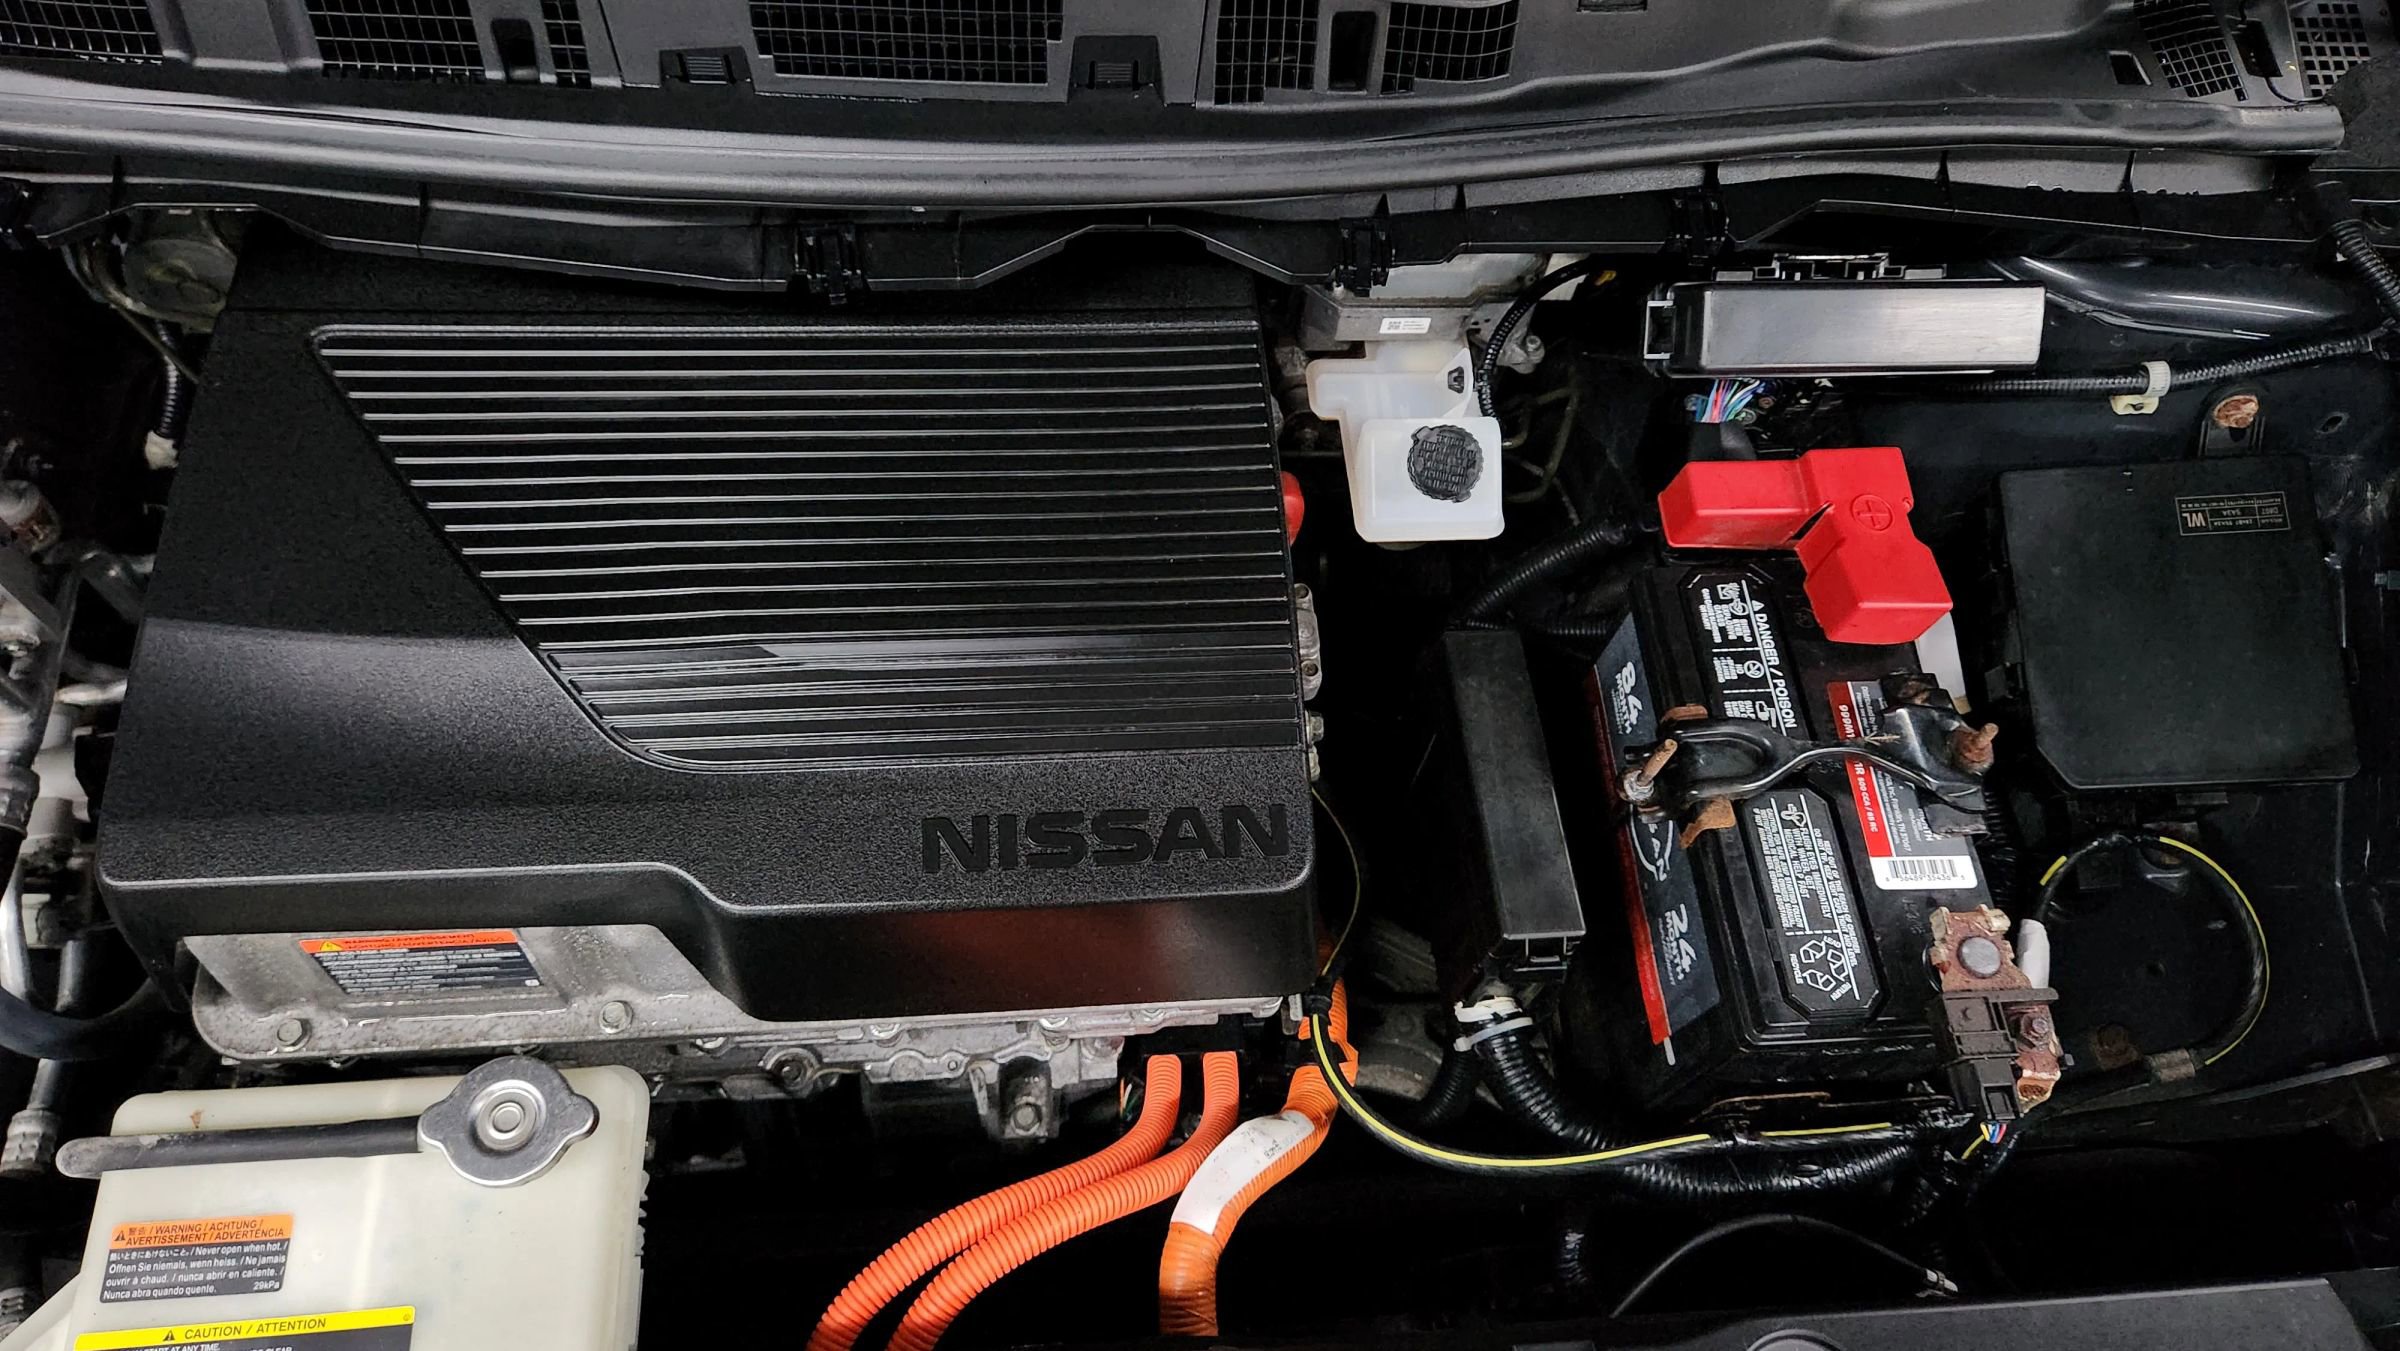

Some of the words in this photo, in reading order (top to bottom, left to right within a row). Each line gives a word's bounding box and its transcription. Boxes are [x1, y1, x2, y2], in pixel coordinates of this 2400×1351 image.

[2181, 511, 2207, 528] WL
[1734, 664, 1745, 674] NO
[1754, 613, 1781, 665] DANGER
[1772, 679, 1798, 728] POISON
[1615, 673, 1633, 735] MONTH
[1619, 661, 1644, 725] 84
[922, 804, 1291, 874] NISSAN
[1783, 828, 1799, 858] MEDICAL
[1799, 827, 1814, 850] FLUSH
[1791, 828, 1804, 847] WITH
[1804, 875, 1816, 891] GET
[1791, 860, 1805, 879] HELP
[1806, 852, 1819, 870] EYES
[1797, 880, 1810, 899] FAST
[1811, 871, 1832, 919] IMMEDIATELY
[1664, 910, 1685, 981] MONTH
[1671, 903, 1698, 973] 24
[1788, 954, 1805, 985] RECYCLE
[155, 1221, 202, 1235] WARNING
[209, 1219, 258, 1232] ACHTUNG
[125, 1232, 207, 1247] AVERTISSEMENT
[194, 1246, 220, 1256] Never
[220, 1245, 242, 1256] open
[243, 1243, 265, 1253] when
[266, 1242, 283, 1251] hot.
[137, 1262, 152, 1273] Sie
[152, 1259, 189, 1272] niemals,
[189, 1259, 213, 1270] wenn
[244, 1255, 257, 1266] Ne
[256, 1254, 286, 1267] jamais
[105, 1277, 131, 1288] ouvrir
[140, 1273, 169, 1285] chaud.
[177, 1271, 204, 1283] nunca
[205, 1268, 227, 1280] abrir
[228, 1269, 240, 1279] en
[241, 1266, 278, 1279] caliente.
[252, 1280, 280, 1291] 29kPa
[102, 1289, 131, 1301] Nunca
[131, 1287, 152, 1299] abra
[152, 1285, 184, 1298] quando
[184, 1284, 218, 1296] quente.
[184, 1325, 242, 1340] CAUTION
[256, 1317, 327, 1333] ATTENTION
